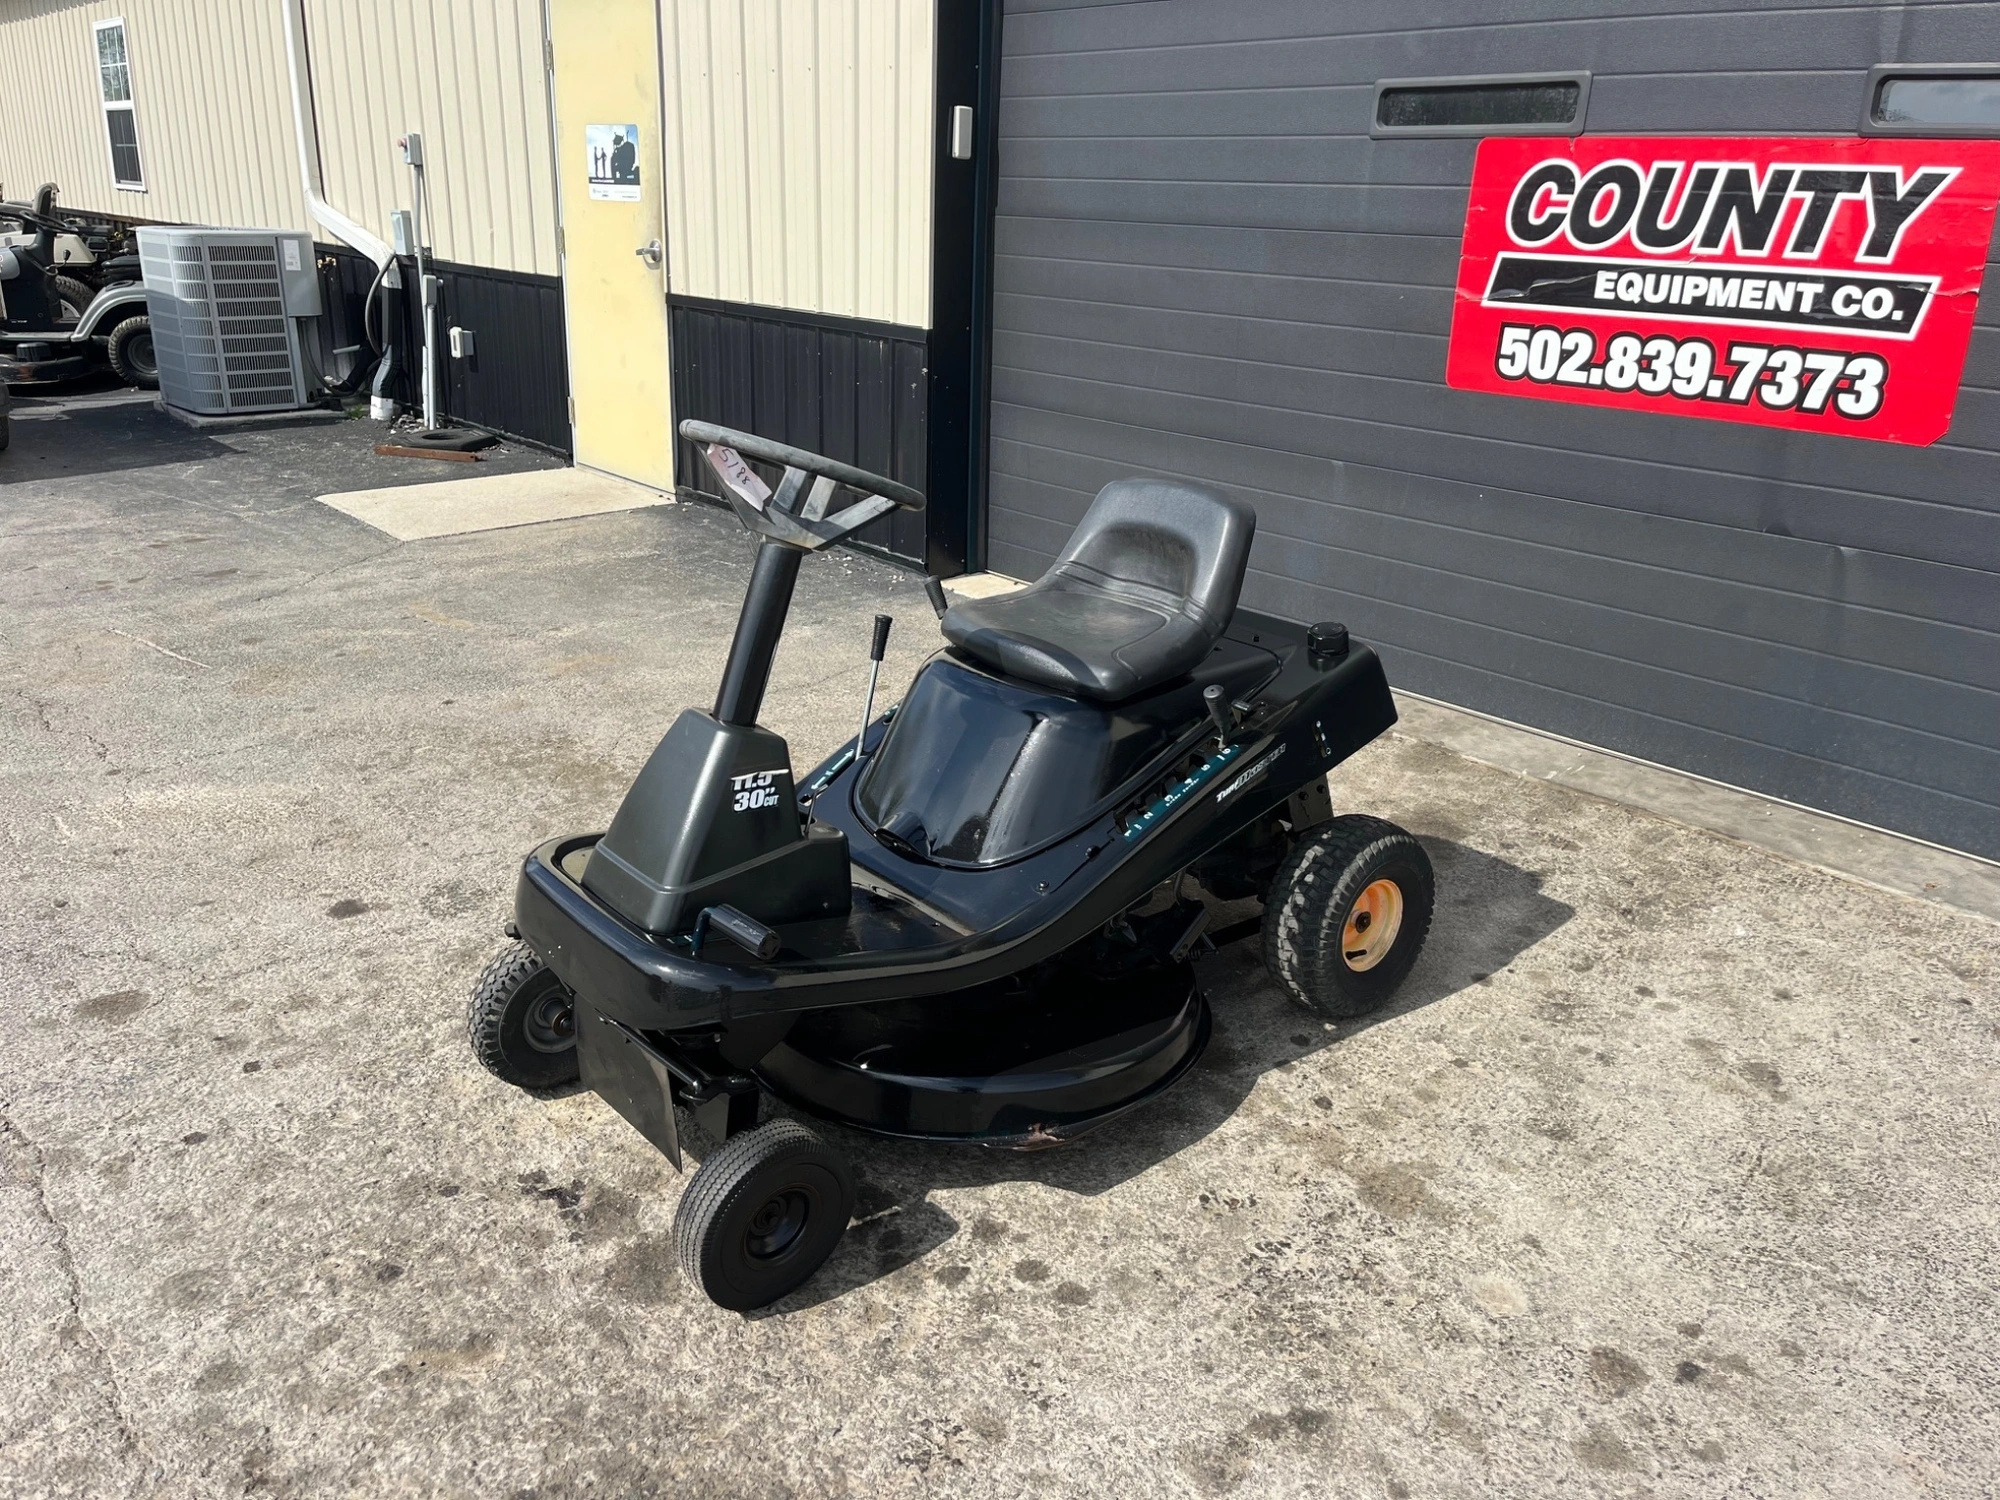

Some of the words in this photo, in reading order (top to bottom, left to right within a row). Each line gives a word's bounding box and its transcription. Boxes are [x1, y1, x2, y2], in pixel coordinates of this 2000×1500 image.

[1505, 158, 1963, 264] COUNTY
[1594, 270, 1824, 315] EQUIPMENT
[1831, 289, 1904, 320] CO.
[1497, 324, 1887, 418] 502.839.7373
[730, 769, 780, 790] 11.5
[763, 795, 780, 807] CUT
